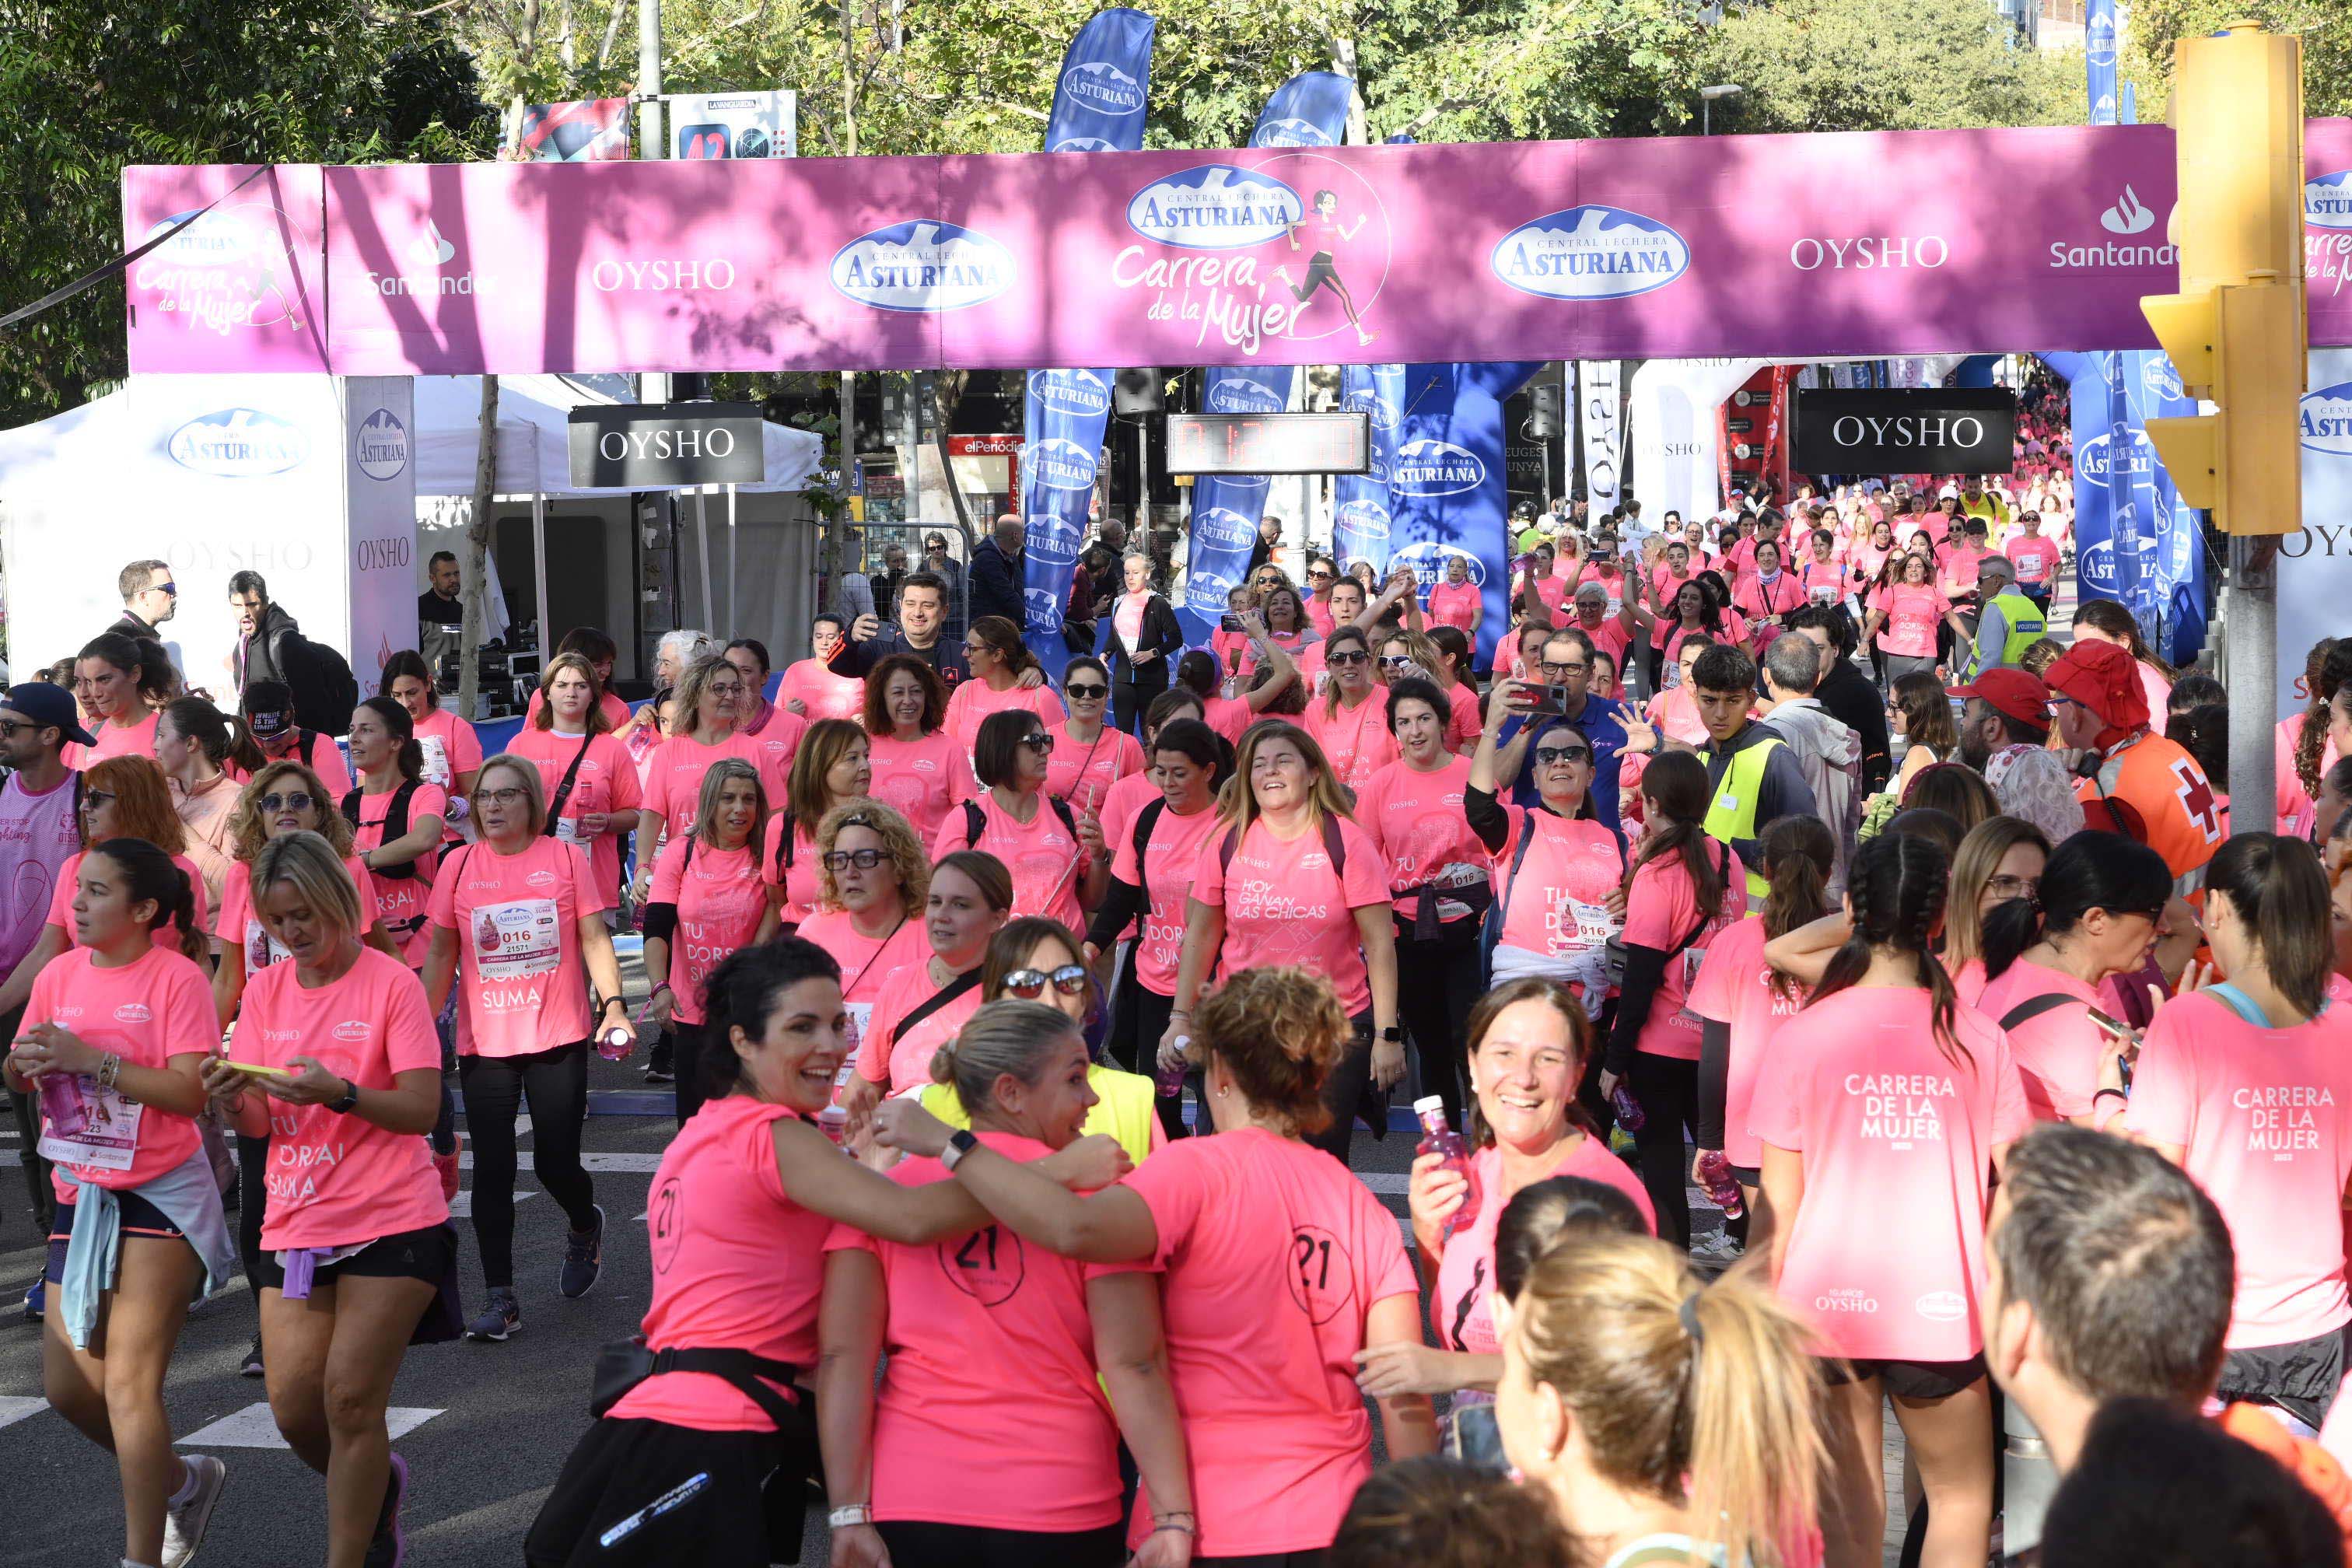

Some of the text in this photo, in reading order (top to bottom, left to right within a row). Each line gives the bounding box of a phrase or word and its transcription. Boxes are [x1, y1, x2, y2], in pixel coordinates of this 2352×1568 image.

[1069, 74, 1136, 108] ASTURIANA
[1167, 194, 1222, 202] CENTRAL
[1139, 196, 1288, 228] ASTURIANA
[1538, 237, 1668, 249] CENTRAL LECHERA
[1790, 235, 1948, 271] OYSHO
[872, 252, 931, 261] CENTRAL
[1507, 242, 1675, 277] ASTURIANA
[2050, 242, 2179, 268] Santand
[593, 259, 735, 292] OYSHO
[843, 255, 1000, 288] ASTURIANA
[1112, 244, 1258, 289] Carrera
[2323, 257, 2336, 278] la
[363, 272, 498, 296] Santander
[1147, 282, 1312, 355] de la Mujer
[1215, 390, 1277, 413] ASTURIANA
[1833, 415, 1983, 448] OYSHO
[180, 433, 300, 460] ASTURIANA
[360, 436, 405, 463] ASTURIANA
[600, 429, 735, 461] OYSHO
[166, 539, 313, 571] OYSHO
[358, 537, 409, 571] OYSHO
[1389, 799, 1419, 810] OYSHO
[1236, 856, 1270, 869] OYSHO
[1396, 857, 1415, 872] TU
[468, 880, 501, 890] OYSHO
[376, 887, 415, 911] RSAL
[1239, 892, 1294, 905] GANAN
[499, 913, 530, 923] ASTURIANA
[1235, 905, 1326, 919] LAS CHICAS
[502, 930, 531, 943] 016
[683, 921, 704, 940] TU
[1580, 926, 1606, 936] 016
[506, 944, 529, 953] 21571
[687, 943, 734, 962] DORS
[530, 958, 556, 968] Santander
[481, 986, 541, 1009] SUMA
[1844, 1074, 1955, 1097] CARRERA
[1866, 1097, 1936, 1118] DE LA
[2232, 1087, 2335, 1108] CARRERA
[271, 1115, 298, 1136] TU
[1860, 1118, 1942, 1140] MUJER
[2252, 1108, 2315, 1129] DE LA
[48, 1144, 75, 1156] OYSHO
[2246, 1130, 2319, 1151] MUJER
[657, 1189, 676, 1238] 21
[1297, 1234, 1331, 1290] 21
[1815, 1297, 1878, 1313] OYSHO
